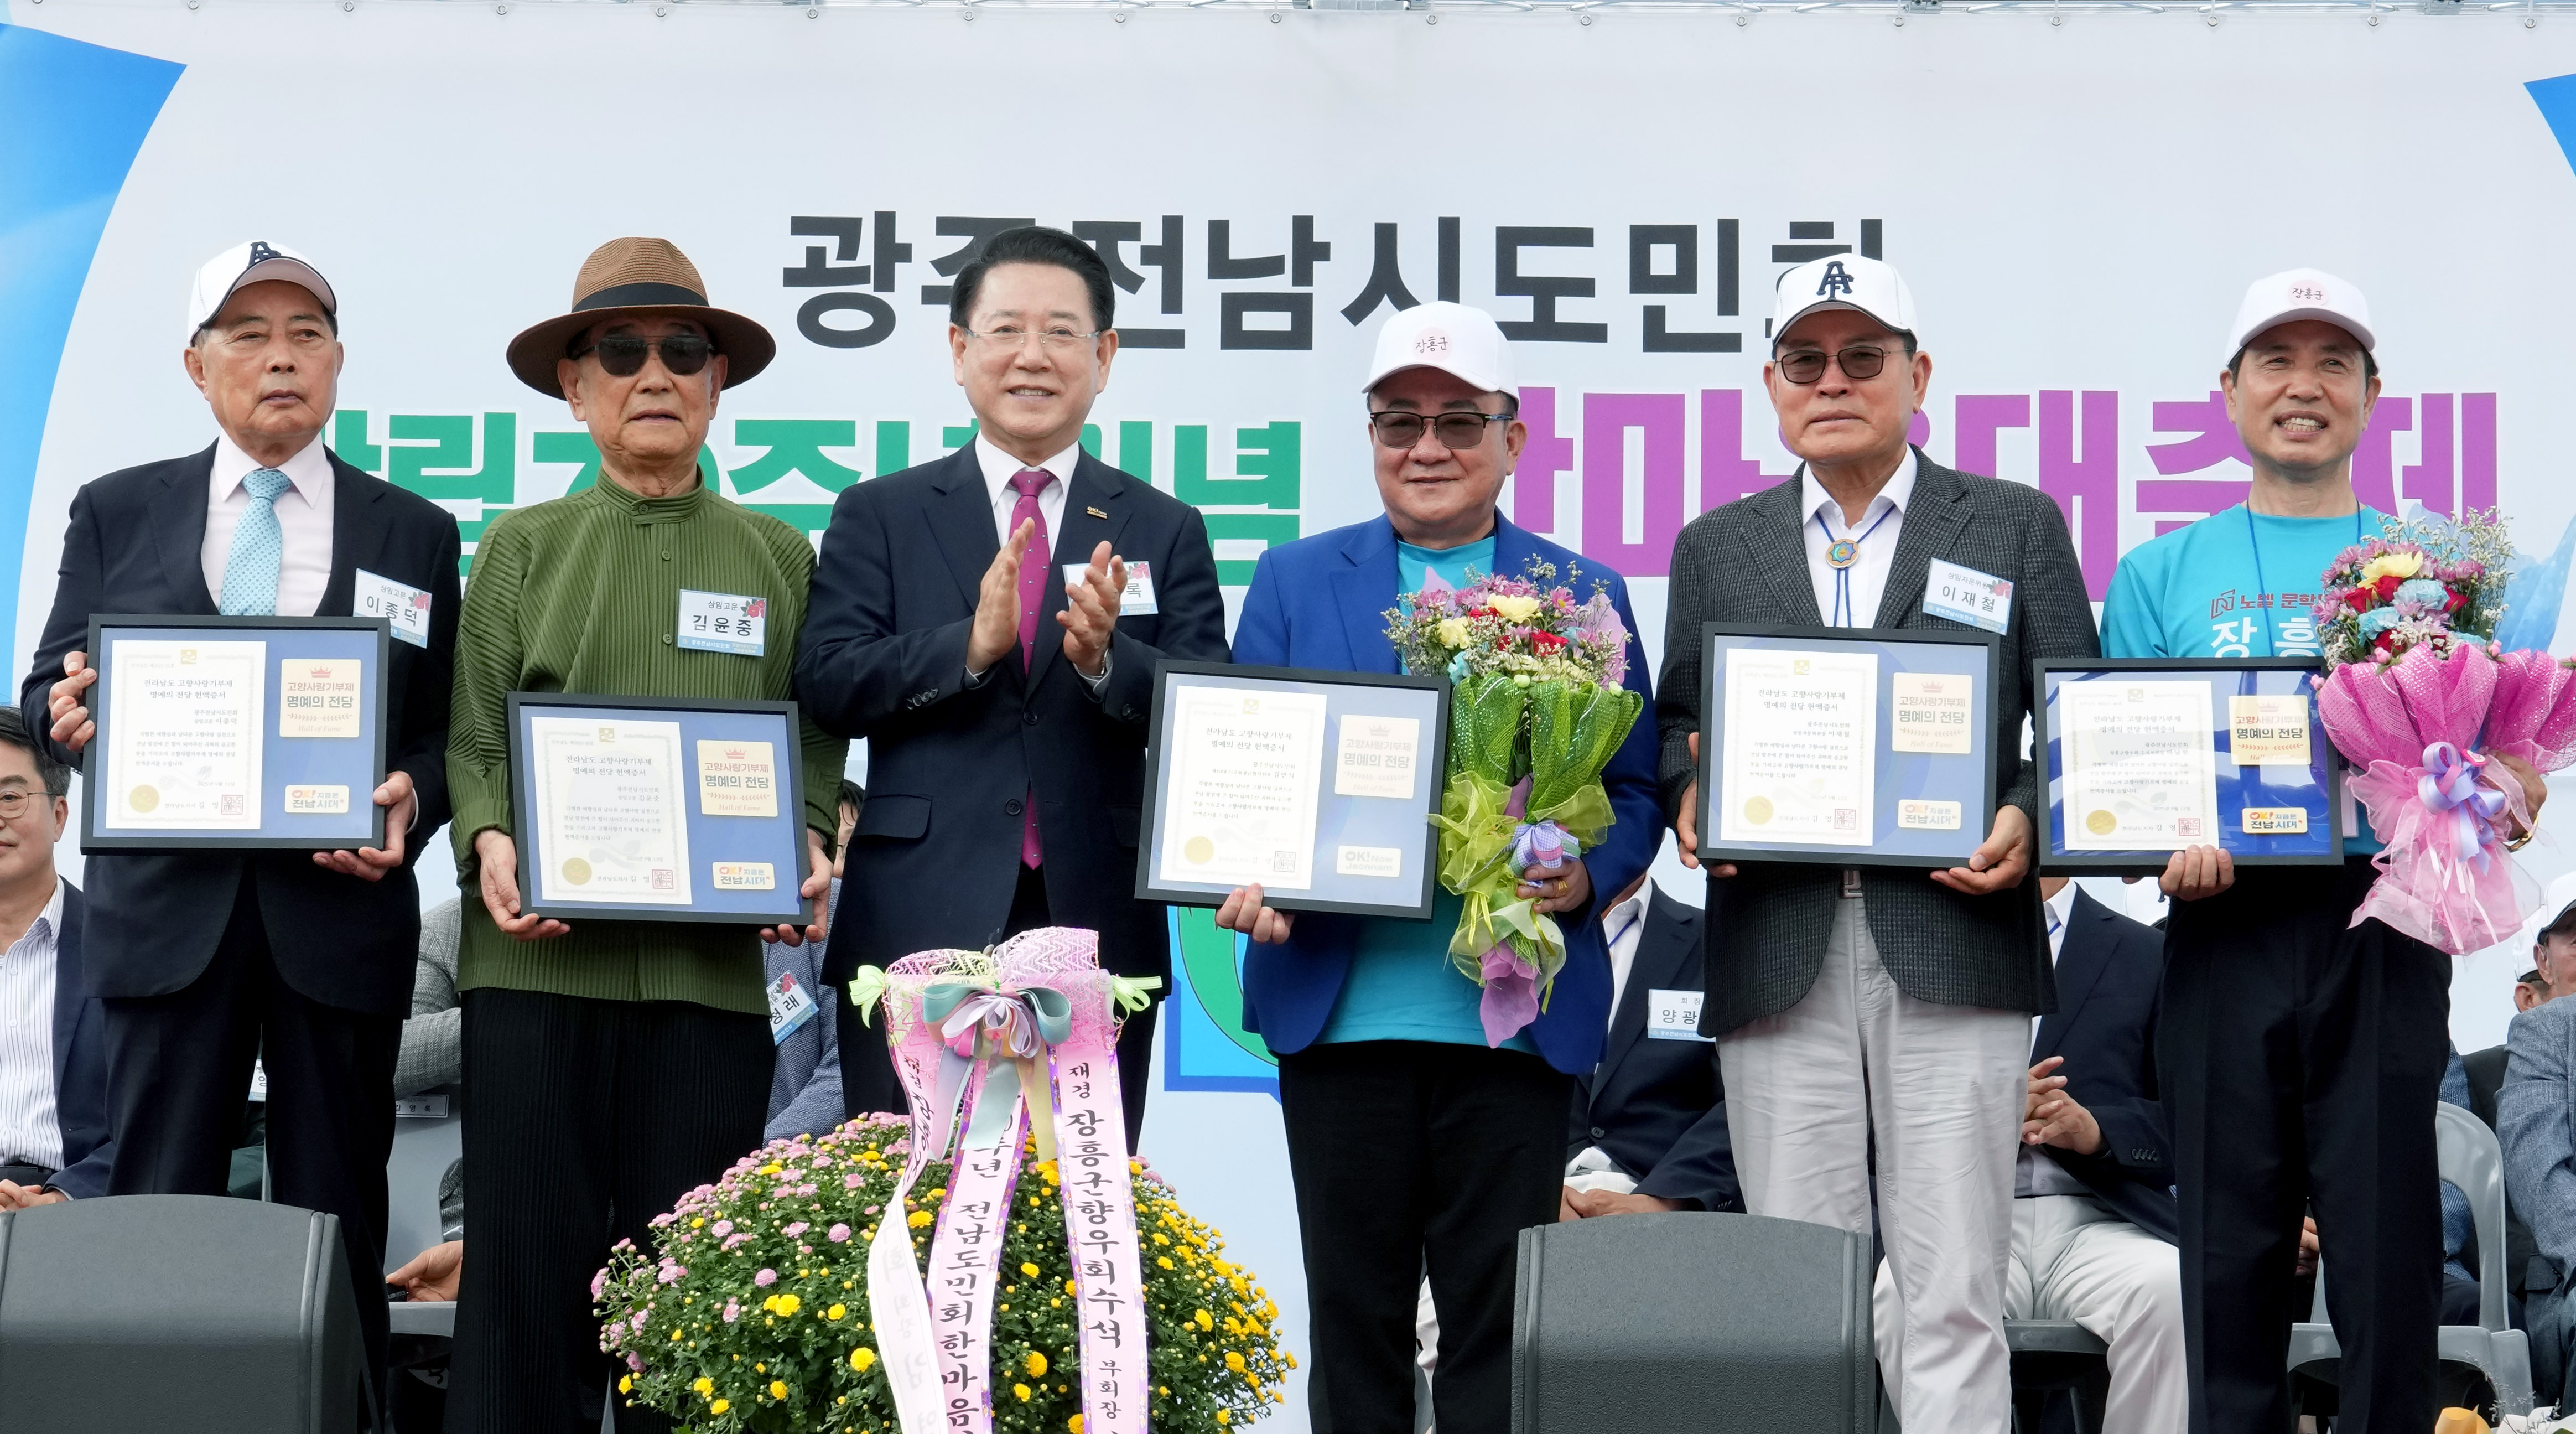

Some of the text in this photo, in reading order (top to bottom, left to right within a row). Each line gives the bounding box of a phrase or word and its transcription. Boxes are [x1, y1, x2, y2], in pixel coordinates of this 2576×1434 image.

[2292, 287, 2324, 301] 장흥군
[1415, 336, 1449, 354] 장흥군
[381, 584, 407, 600] 상임고문
[708, 600, 738, 611] 상임고문
[1942, 586, 1996, 613] 이재철
[2281, 593, 2325, 609] 문학
[693, 615, 752, 637] 김윤중
[692, 639, 730, 649] 광주전남시도민회
[143, 679, 233, 687] 전라남도 고향사랑기부제
[287, 682, 354, 692] 고향사랑기부제
[149, 690, 226, 699] 명예의 전당 헌액증서
[1757, 688, 1845, 700] 전라남도 고향사랑기부제
[286, 695, 354, 708] 명예의 전당
[1764, 701, 1838, 712] 명예의 전당 헌액증서
[1899, 696, 1966, 708] 고향사랑기부제
[1899, 709, 1965, 724] 명예의 전당
[1204, 727, 1292, 741] 전라남도 고향사랑기부제
[2236, 727, 2303, 739] 명예의 전당
[1210, 739, 1285, 753] 명예의 전당 헌액증서
[1344, 738, 1411, 752] 고향사랑기부제
[565, 754, 652, 765] 전라남도 고향사랑기부제
[1343, 752, 1410, 769] 명예의 전당
[572, 767, 646, 777] 명예의 전당 헌액증서
[704, 762, 768, 773] 고향사랑기부제
[705, 774, 770, 789] 명예의 전당
[1680, 997, 1701, 1006] 회장
[1069, 1062, 1091, 1099] 재경
[938, 1200, 991, 1434] 전남도민회한마음
[1098, 1360, 1122, 1420] 부회장
